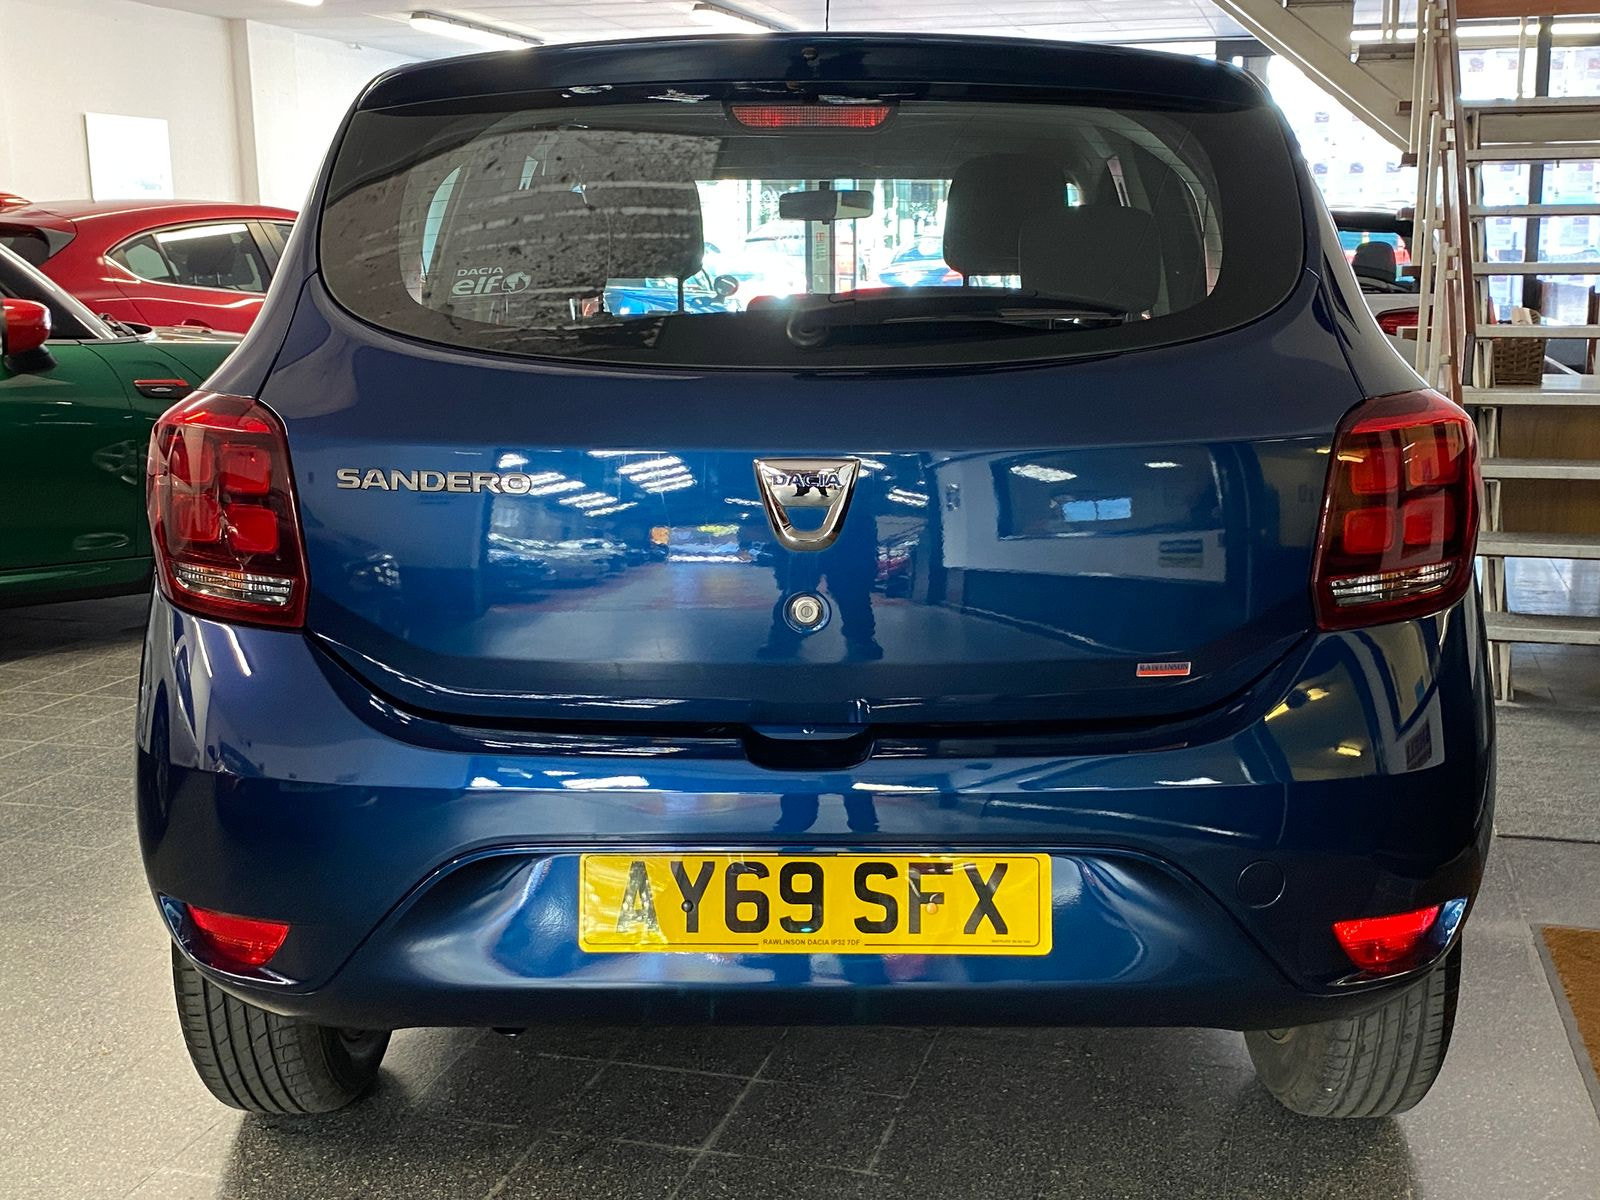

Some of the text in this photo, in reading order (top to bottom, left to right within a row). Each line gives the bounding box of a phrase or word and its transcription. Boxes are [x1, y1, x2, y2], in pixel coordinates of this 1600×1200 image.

[456, 266, 504, 277] DACIA
[336, 468, 532, 495] SANDERO
[771, 473, 842, 487] DACIA
[616, 860, 1009, 935] AY69 SFX
[762, 938, 806, 946] RAWLINSON
